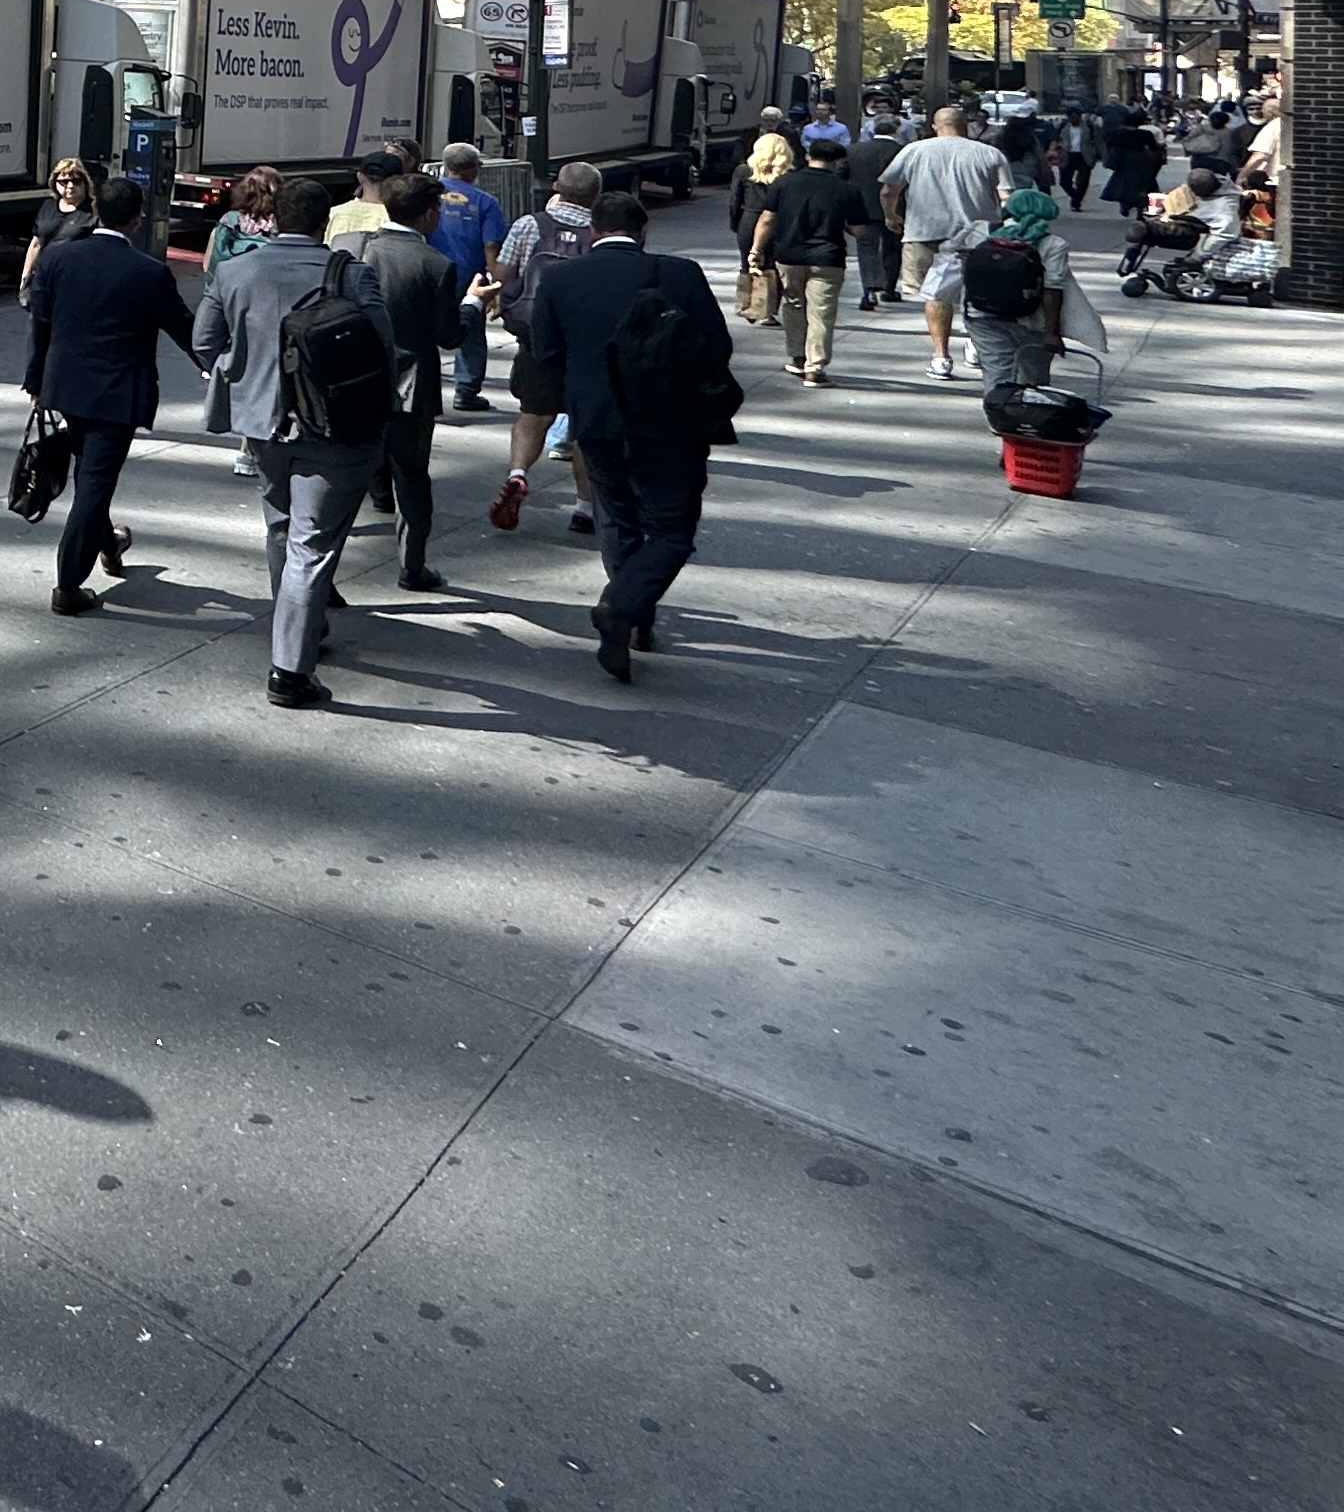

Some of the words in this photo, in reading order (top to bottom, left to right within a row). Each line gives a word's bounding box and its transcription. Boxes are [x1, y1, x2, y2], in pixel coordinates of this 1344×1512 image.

[217, 8, 249, 37] Less
[253, 11, 300, 40] Kevin.
[215, 49, 256, 76] More
[260, 50, 305, 78] bacon.
[214, 94, 228, 109] The
[230, 95, 246, 109] DSP
[248, 95, 262, 109] that
